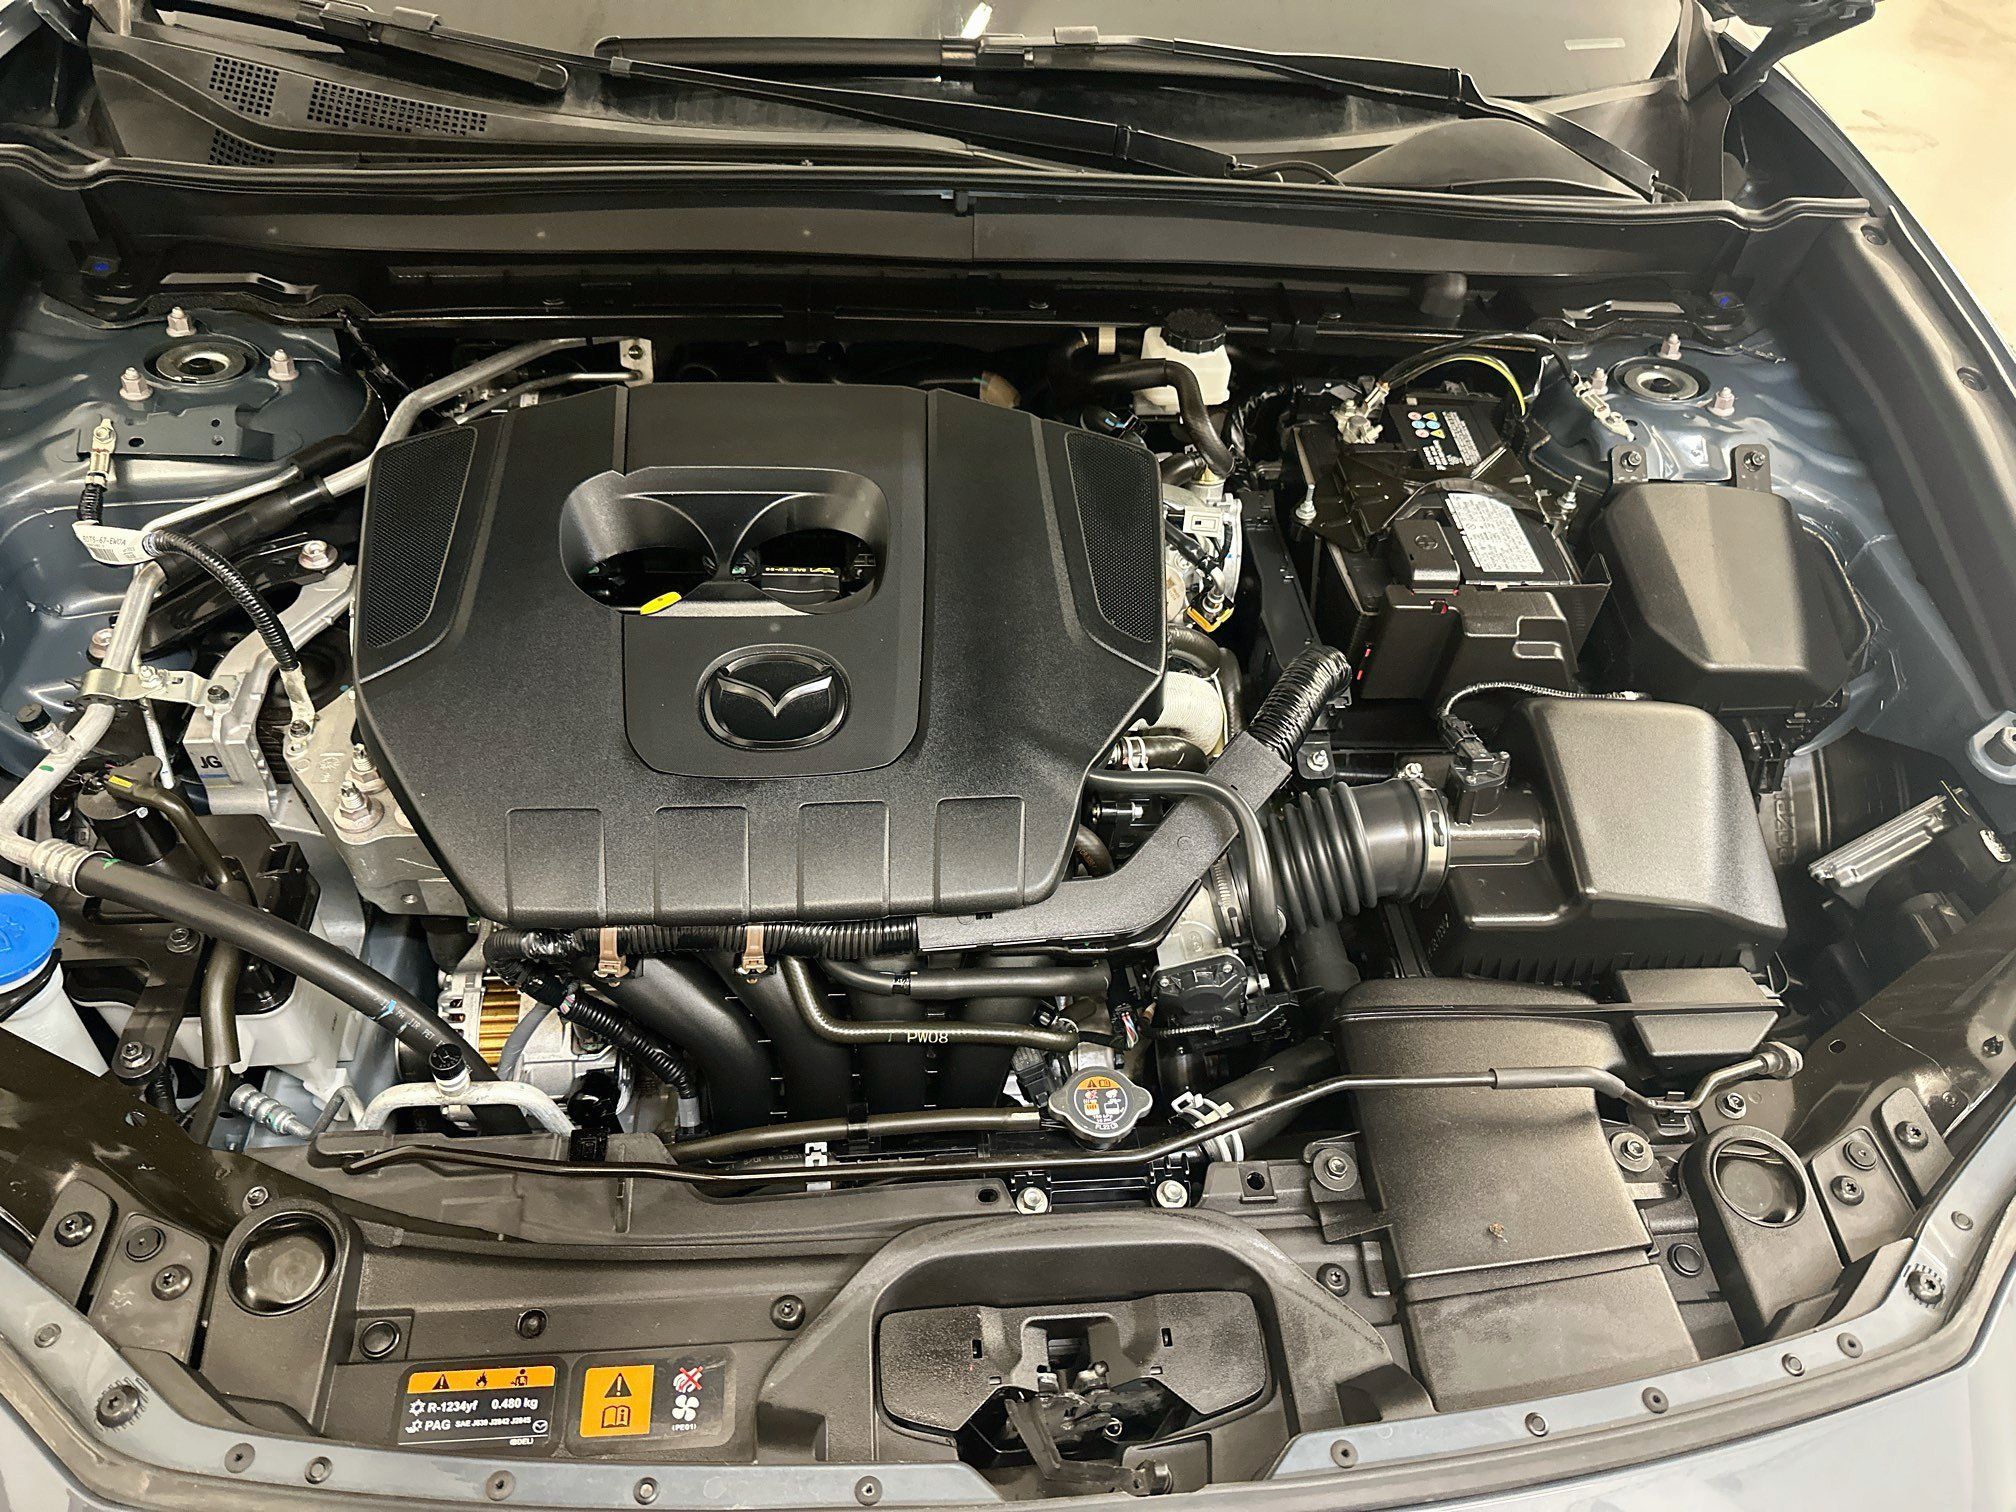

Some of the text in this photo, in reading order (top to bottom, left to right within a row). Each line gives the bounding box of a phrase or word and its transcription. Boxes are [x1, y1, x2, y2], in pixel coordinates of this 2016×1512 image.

[200, 755, 223, 769] JG
[906, 1031, 949, 1044] PW08
[427, 1397, 538, 1414] R-1234yf 0.480 kg
[424, 1419, 451, 1431] PAG
[455, 1420, 471, 1428] SAE
